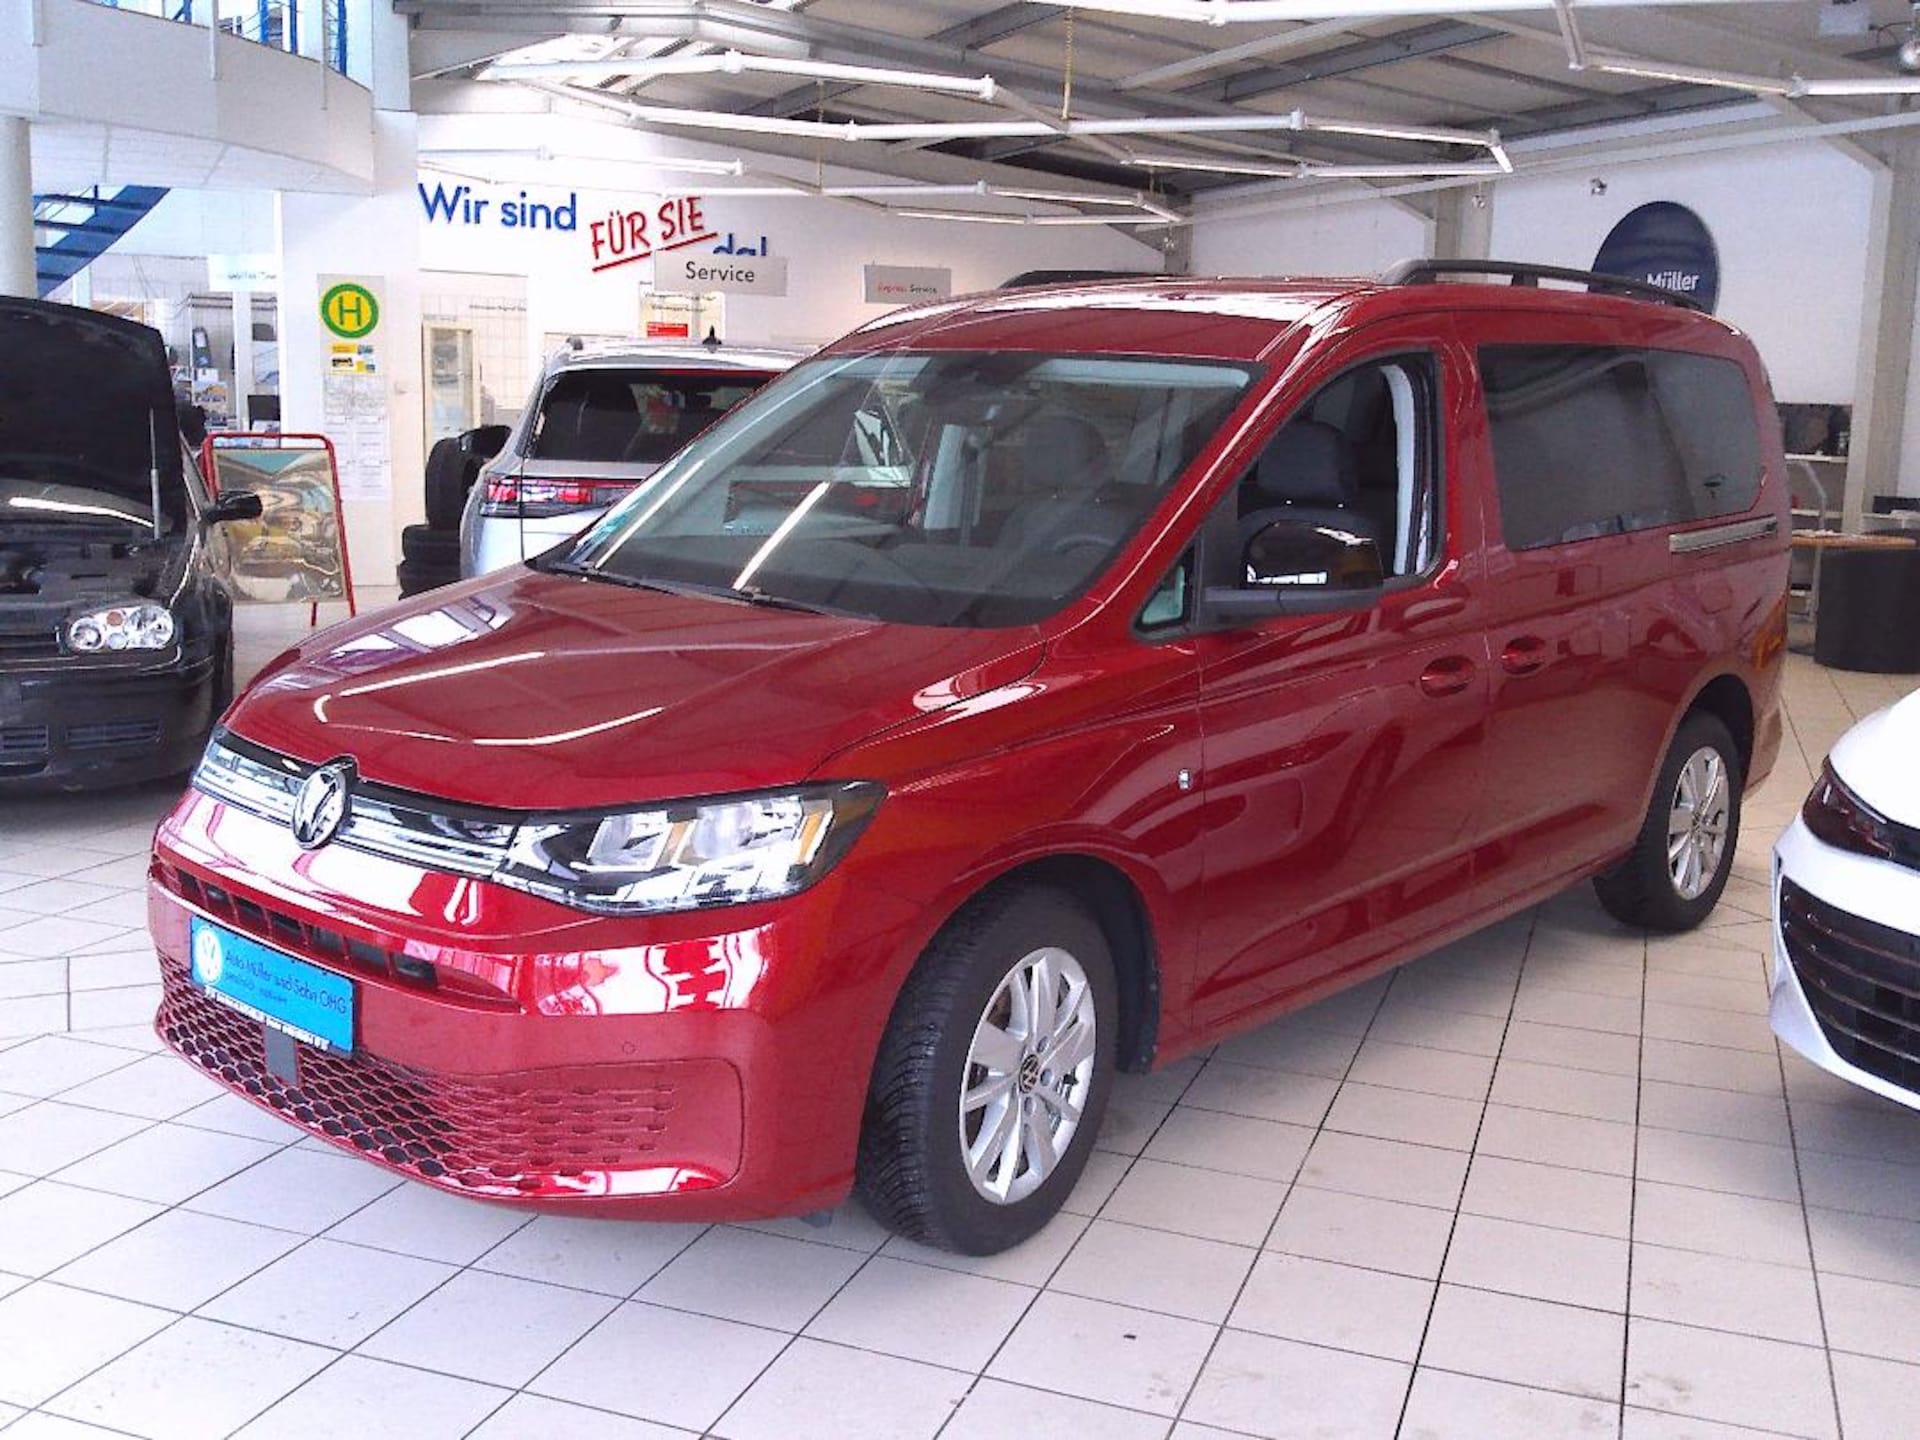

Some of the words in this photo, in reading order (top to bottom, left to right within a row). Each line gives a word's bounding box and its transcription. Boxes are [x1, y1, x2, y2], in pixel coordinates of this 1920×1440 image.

[417, 181, 489, 224] Wir
[500, 191, 577, 231] sind
[590, 210, 651, 260] FÜR
[657, 197, 705, 241] SIE
[685, 260, 755, 283] Service
[1647, 271, 1700, 292] Müller
[338, 295, 362, 327] H
[319, 989, 347, 1015] OHG
